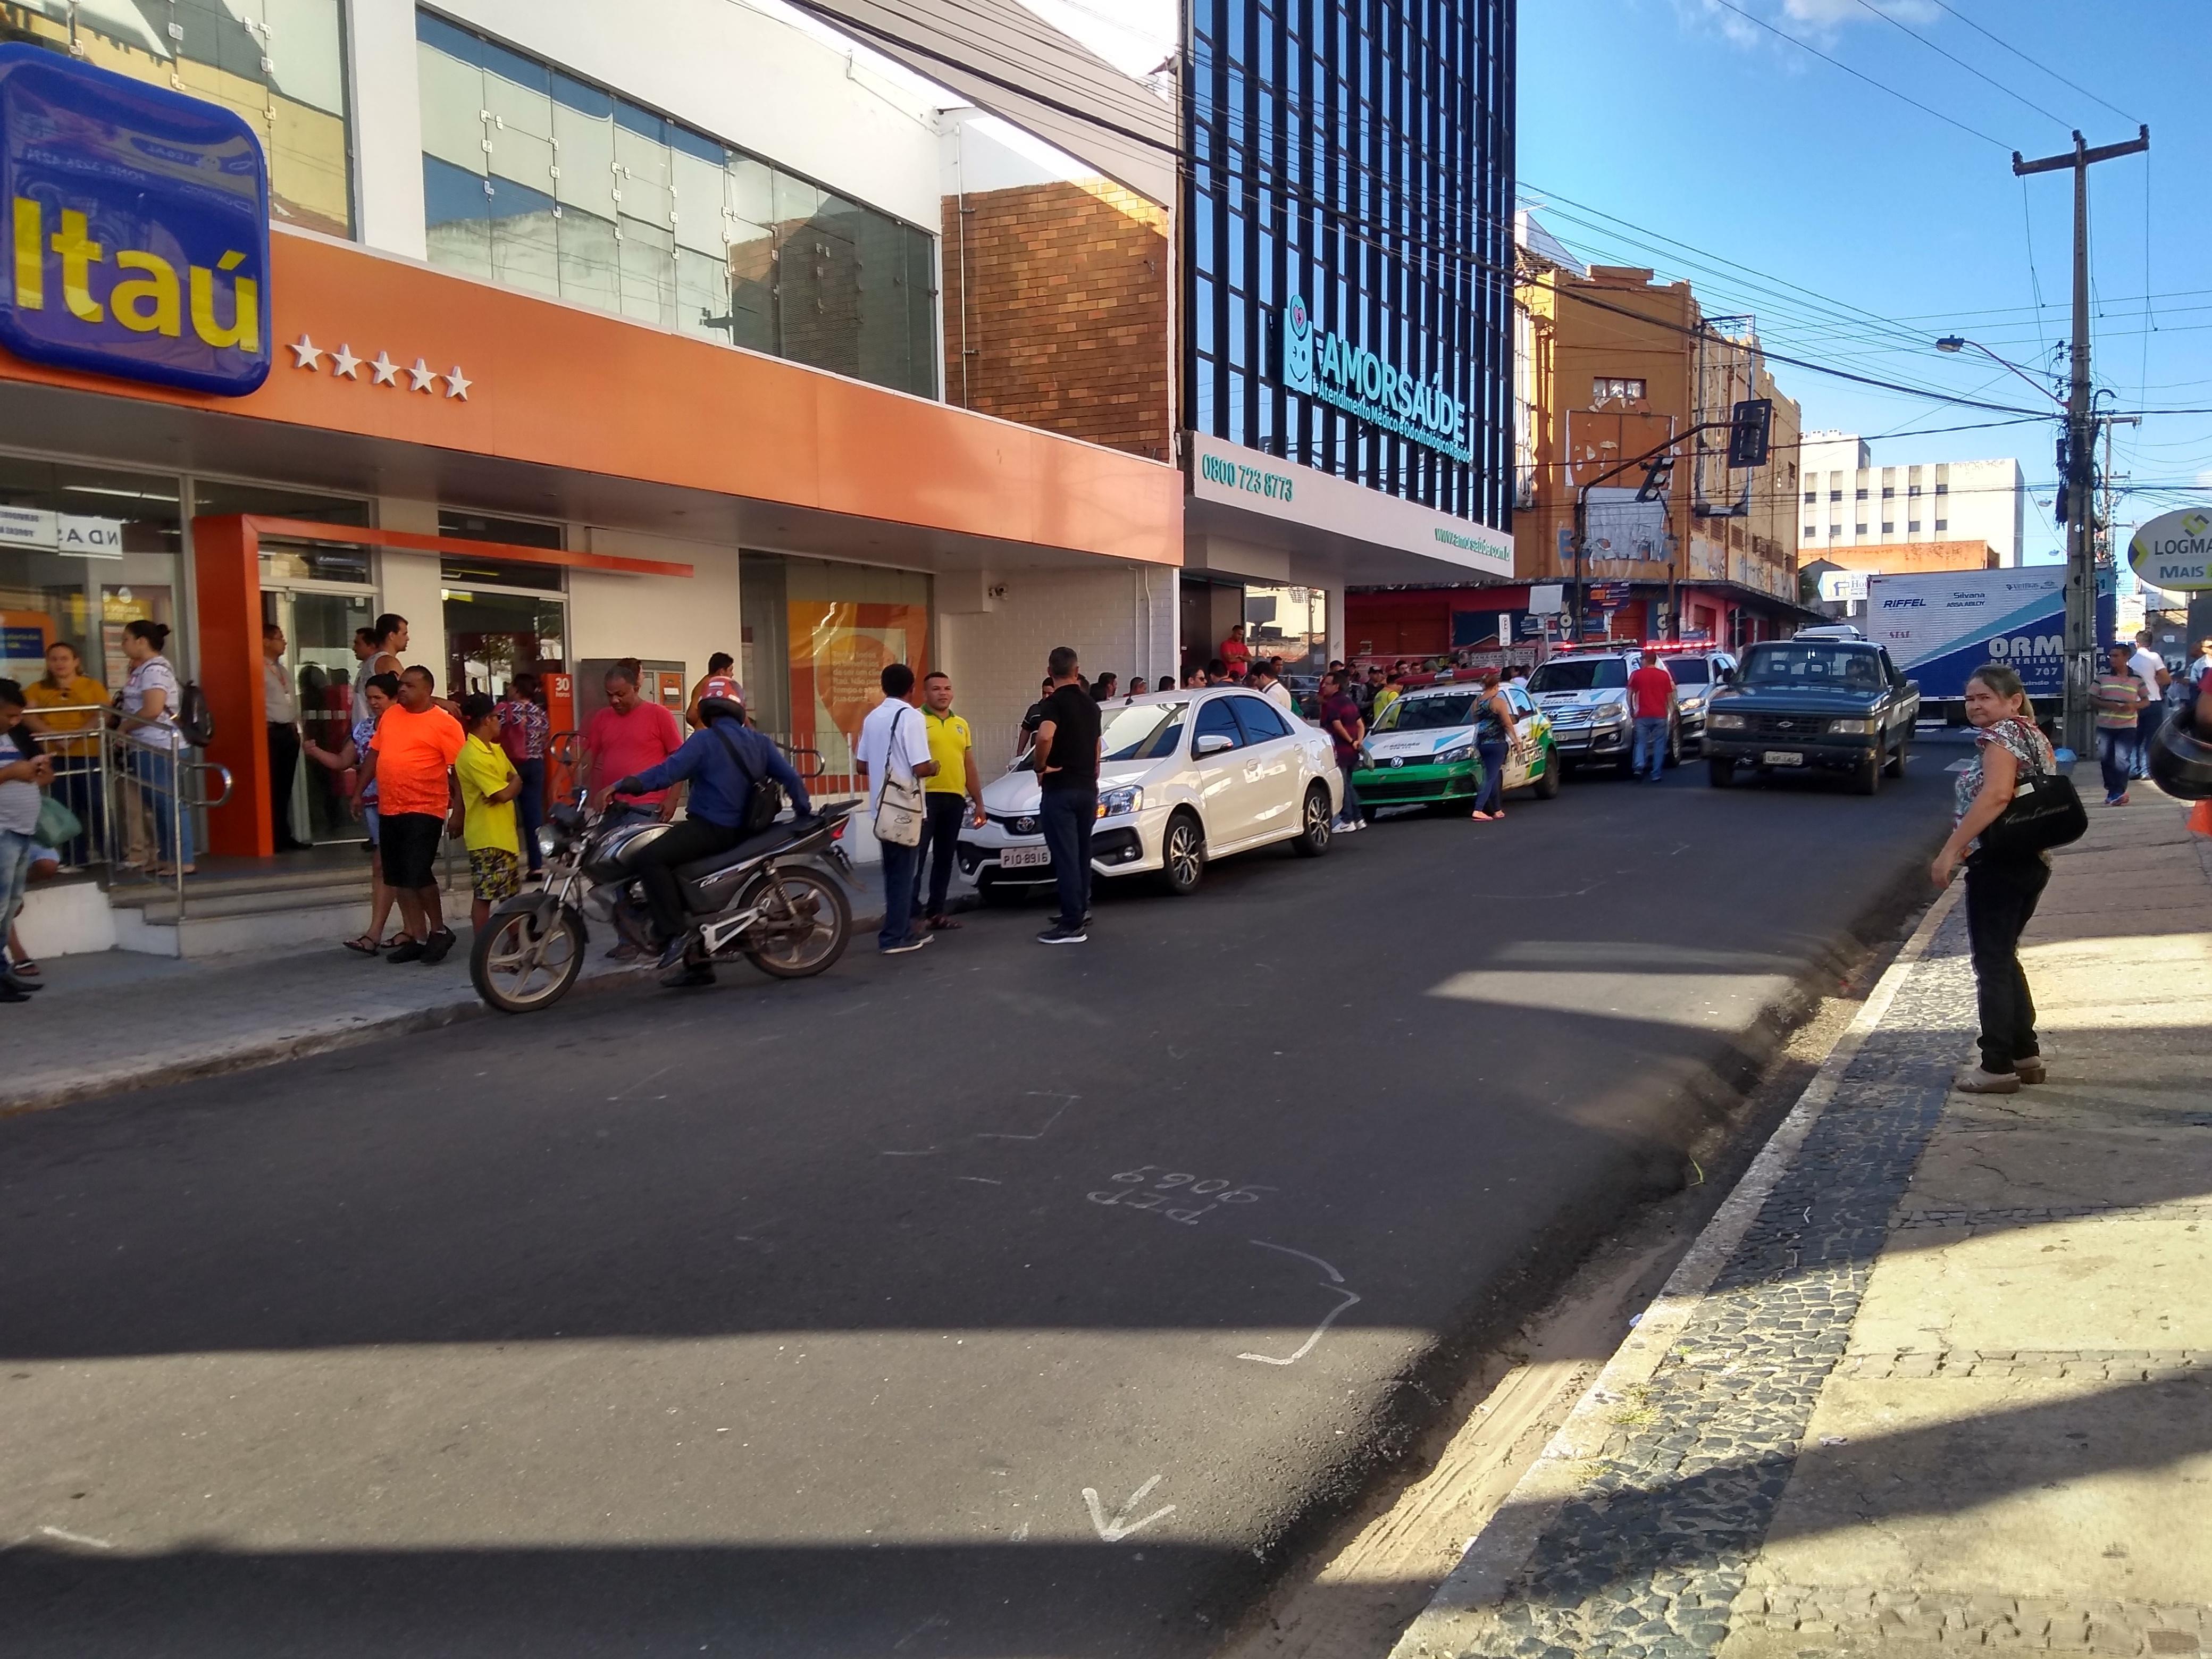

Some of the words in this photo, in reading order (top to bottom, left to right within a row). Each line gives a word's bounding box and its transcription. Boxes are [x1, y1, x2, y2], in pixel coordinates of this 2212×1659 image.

[13, 197, 259, 353] Itaú
[1322, 331, 1465, 442] AMORSAÚDE
[1318, 381, 1370, 421] Atendimento
[1371, 405, 1397, 431] Médico
[1405, 421, 1449, 455] Odontológico
[1202, 454, 1236, 487] 0800
[1239, 464, 1262, 494] 723
[1264, 472, 1293, 502] 8773
[2160, 566, 2204, 579] MAIS
[1883, 599, 1926, 608] RIFFEL
[2035, 667, 2058, 676] 707
[555, 677, 570, 691] 30
[833, 686, 857, 694] tempo
